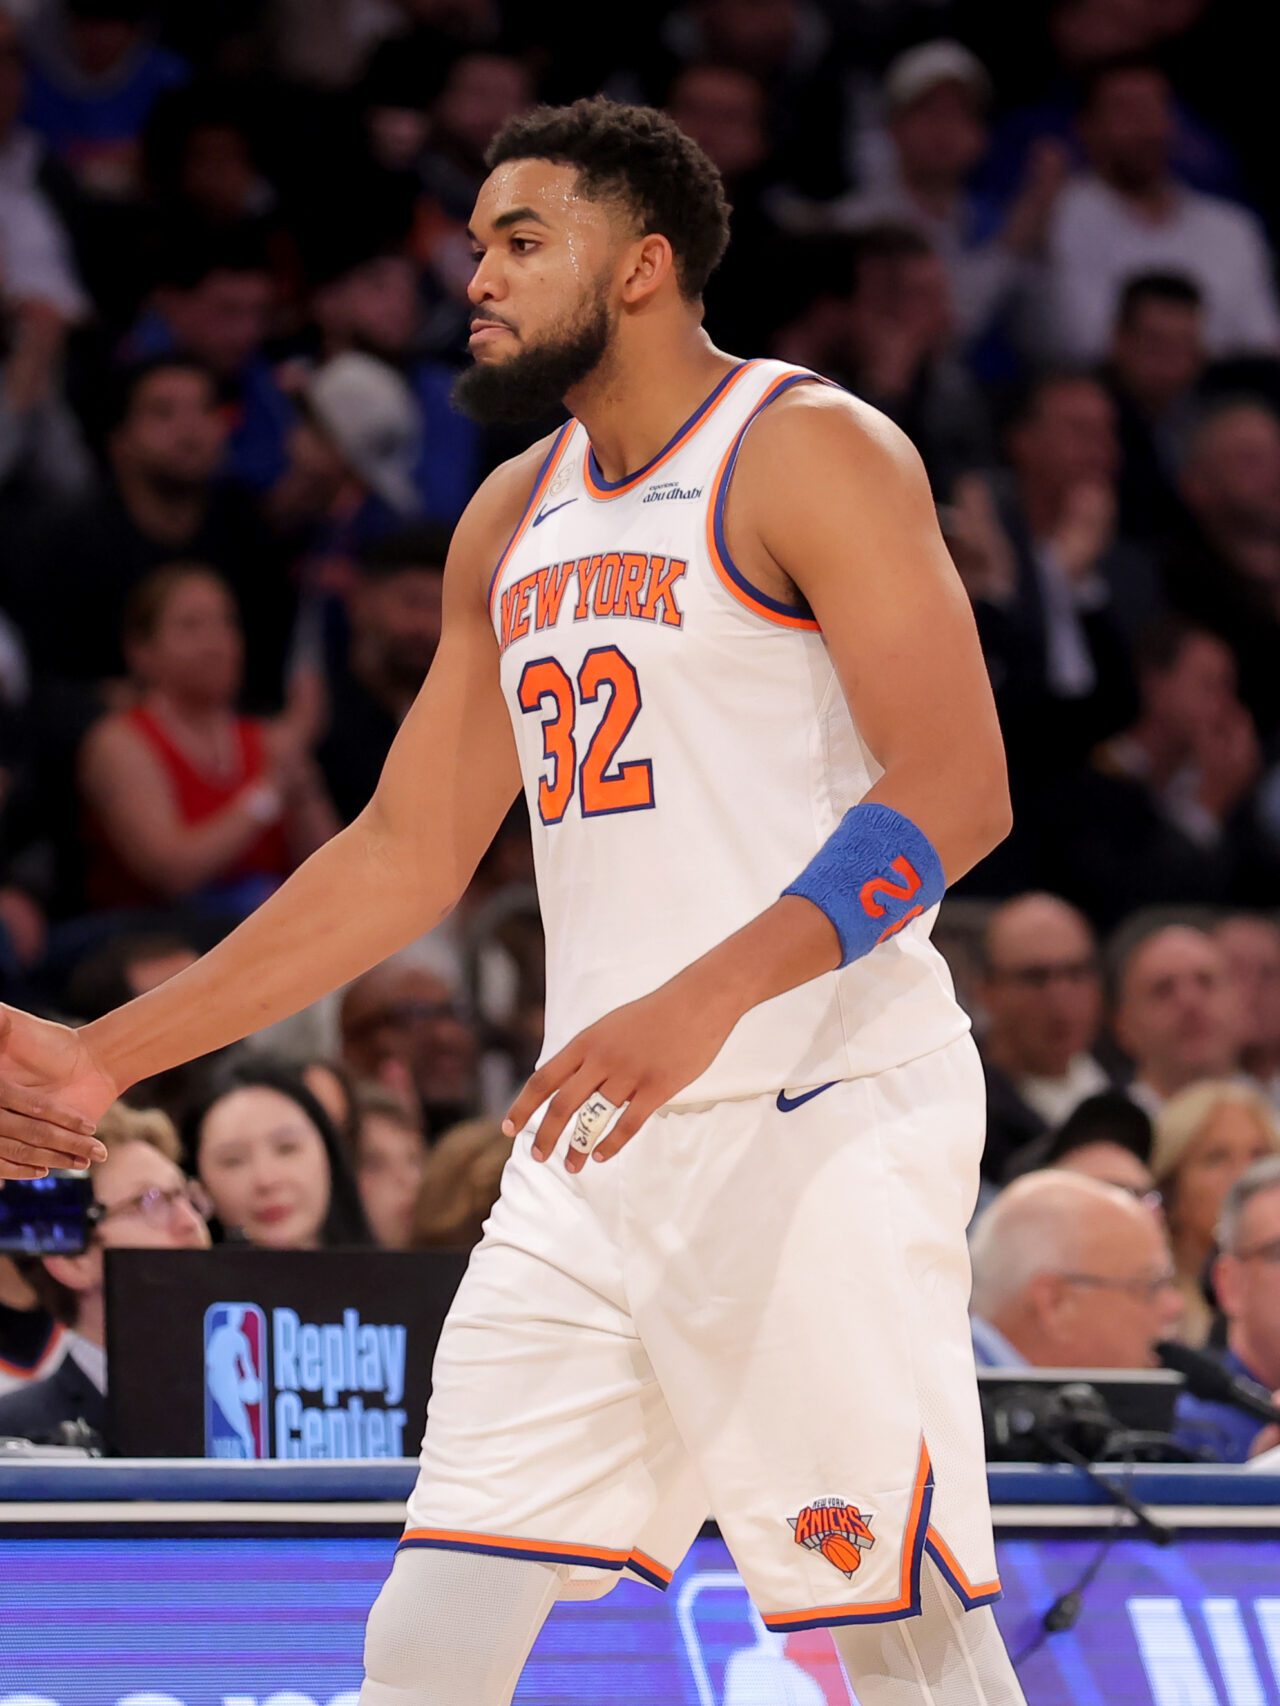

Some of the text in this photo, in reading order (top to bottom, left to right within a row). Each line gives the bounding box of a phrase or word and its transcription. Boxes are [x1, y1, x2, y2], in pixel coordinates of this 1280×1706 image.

[642, 486, 704, 503] abu dhabi
[499, 551, 690, 652] NEW YORK
[517, 644, 656, 826] 32
[272, 1306, 407, 1406] Replay
[275, 1390, 407, 1459] Center
[794, 1504, 876, 1546] KNICKS
[812, 1497, 846, 1509] NEW YORK
